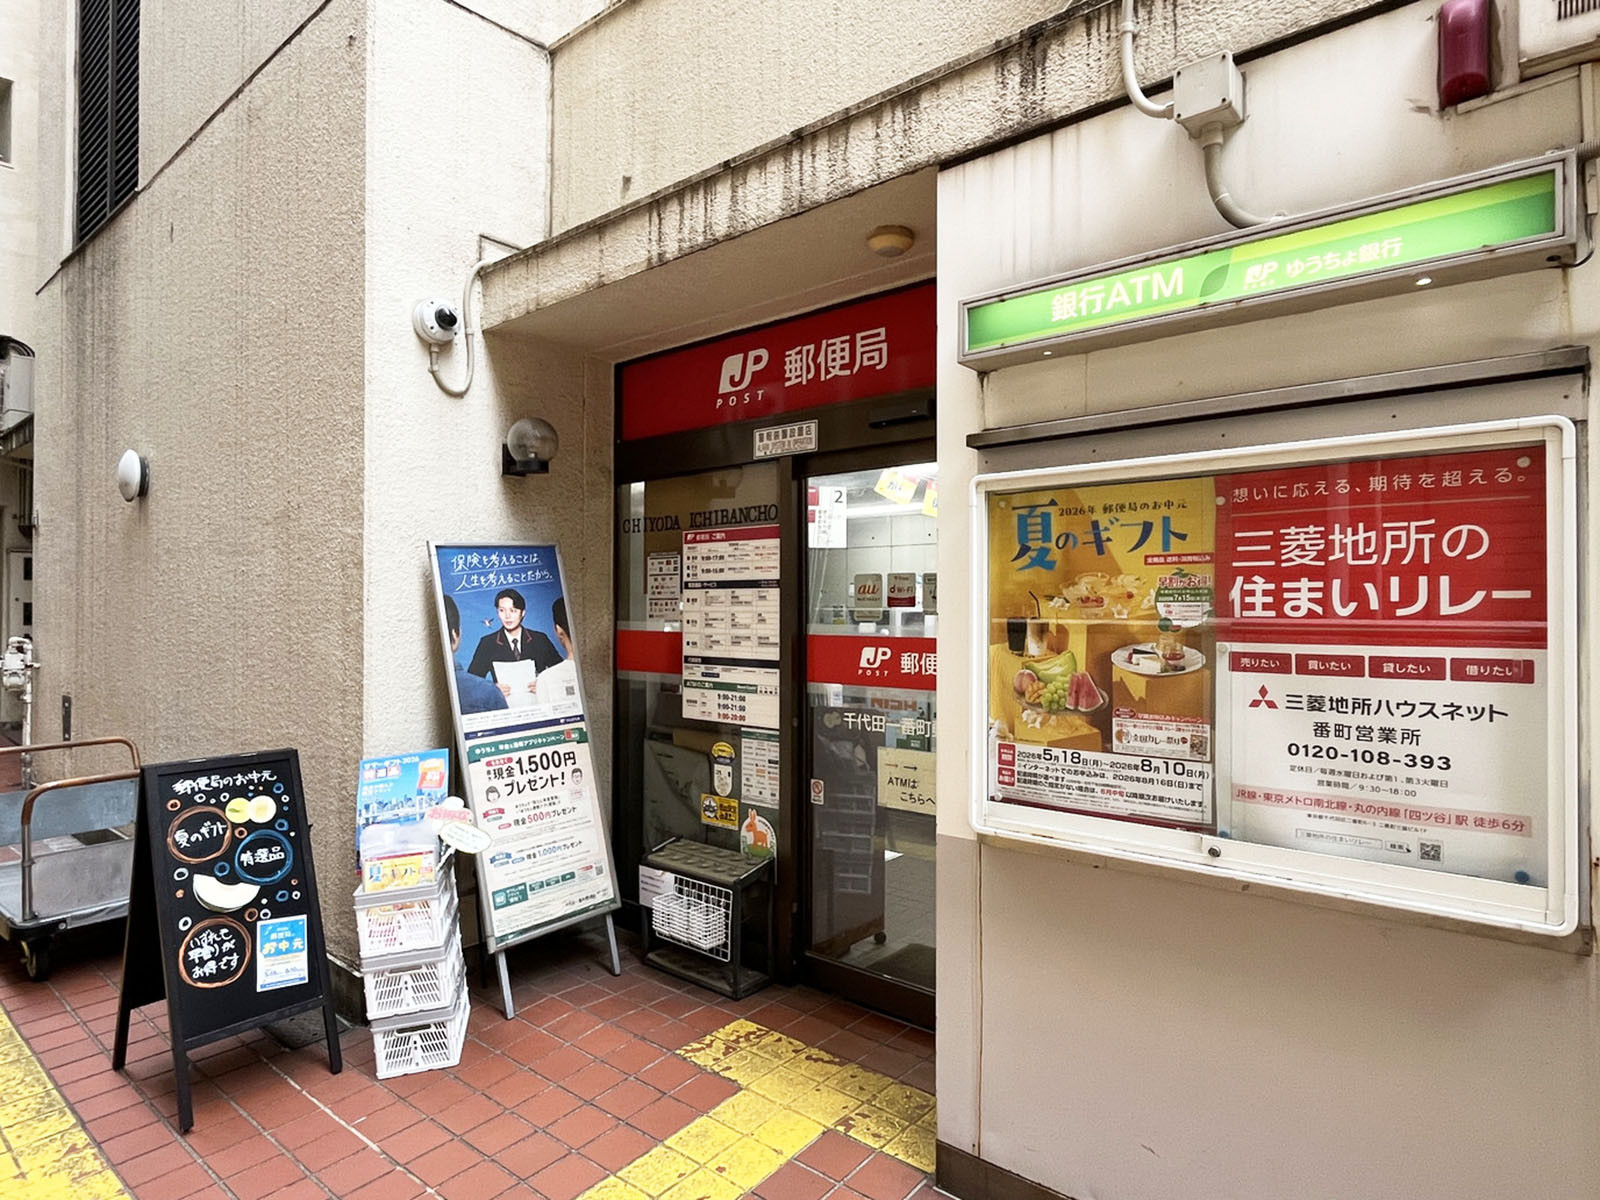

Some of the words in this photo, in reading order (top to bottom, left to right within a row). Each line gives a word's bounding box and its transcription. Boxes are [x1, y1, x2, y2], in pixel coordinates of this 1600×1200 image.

[1286, 237, 1404, 278] ゆうちょ銀行
[1051, 267, 1184, 322] 銀行ATM
[718, 348, 769, 394] JP
[784, 327, 888, 387] 郵便局
[716, 390, 765, 409] POST
[834, 490, 843, 503] 2
[1233, 468, 1527, 503] 想いに応える、期待を超える。
[623, 515, 681, 534] CHIYODA
[689, 504, 778, 528] ICHIBANCHO
[1058, 506, 1096, 517] 2026年
[1102, 499, 1188, 514] 郵便局のお中元
[1011, 498, 1188, 571] 夏のギフト
[1232, 519, 1490, 568] 三菱地所の
[858, 584, 880, 595] au
[1229, 575, 1532, 618] 住まいリレー
[859, 647, 892, 669] JP
[1240, 657, 1280, 669] 売りたい
[1307, 659, 1351, 671] 買いたい
[1382, 662, 1431, 674] 貸したい
[858, 669, 889, 677] POST
[1285, 694, 1509, 722] 三菱地所ハウスネット
[1313, 721, 1422, 747] 番町営業所
[493, 750, 577, 780] 現金1,500円
[1288, 743, 1452, 771] 0120-108-393
[172, 770, 278, 795] 郵便局のお中元
[504, 772, 566, 796] プレゼント!
[887, 776, 919, 790] ATMは
[900, 791, 936, 805] こちらへ
[174, 820, 227, 848] 夏のギフト
[1473, 816, 1528, 833] 徒歩6分
[240, 845, 285, 867] 特選品
[262, 938, 304, 954] お中元
[191, 952, 240, 979] お得です
